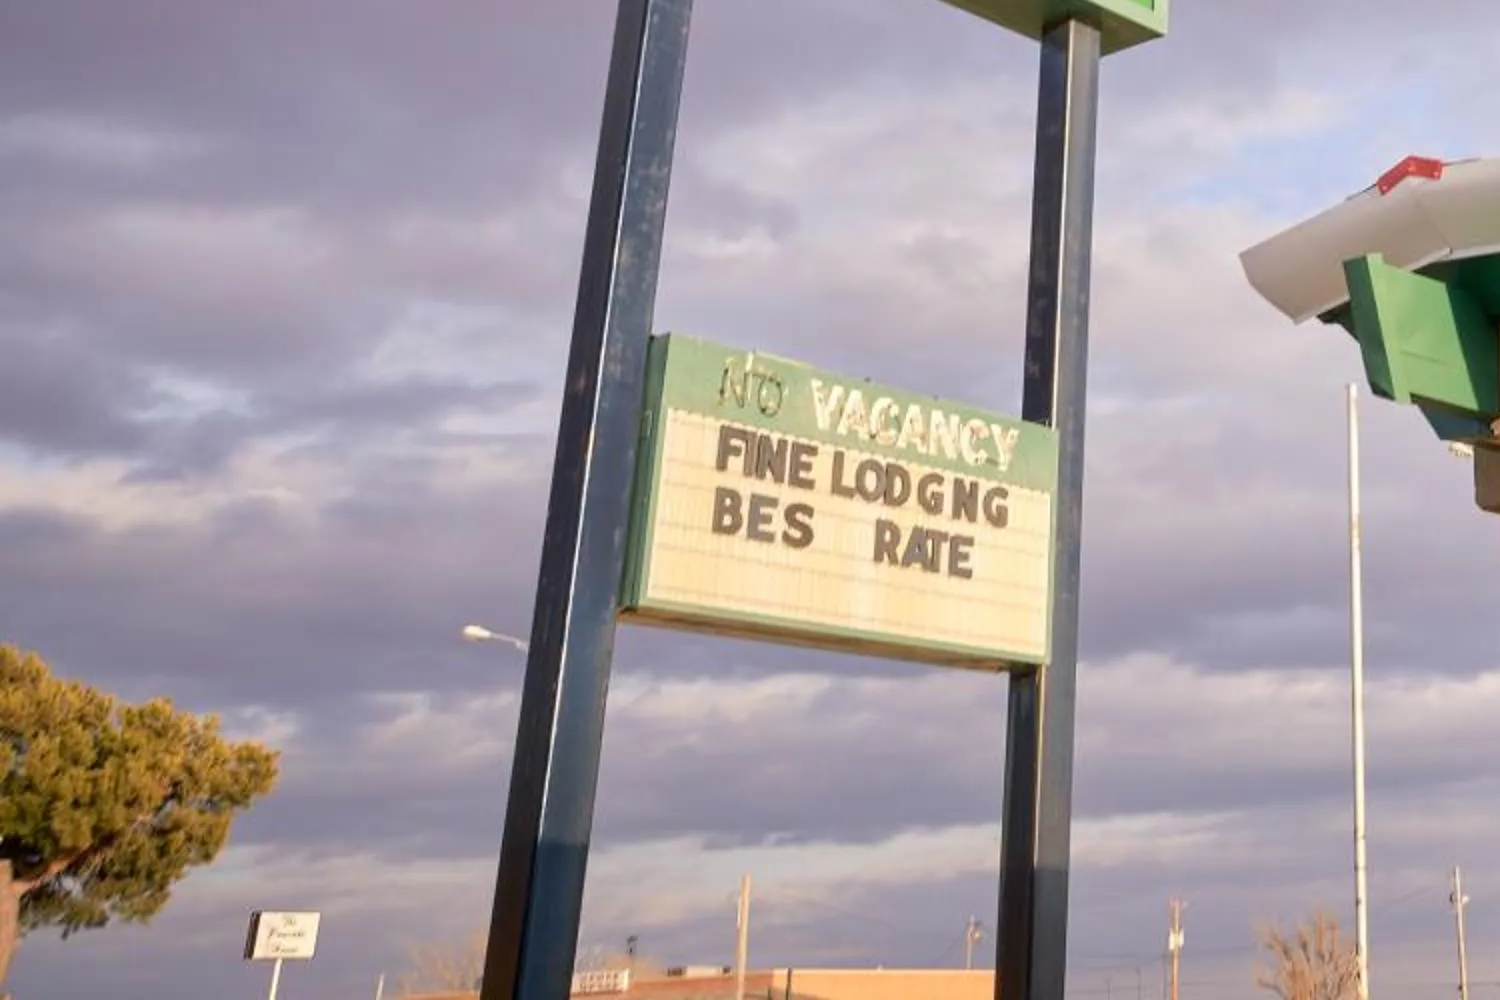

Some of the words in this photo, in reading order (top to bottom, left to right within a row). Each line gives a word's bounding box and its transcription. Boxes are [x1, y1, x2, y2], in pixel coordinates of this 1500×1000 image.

[718, 354, 788, 418] NO
[811, 378, 1020, 472] VACANCY
[715, 424, 819, 491] FINE
[830, 449, 1009, 529] LODGNG
[711, 486, 815, 549] BES
[873, 518, 975, 580] RATE
